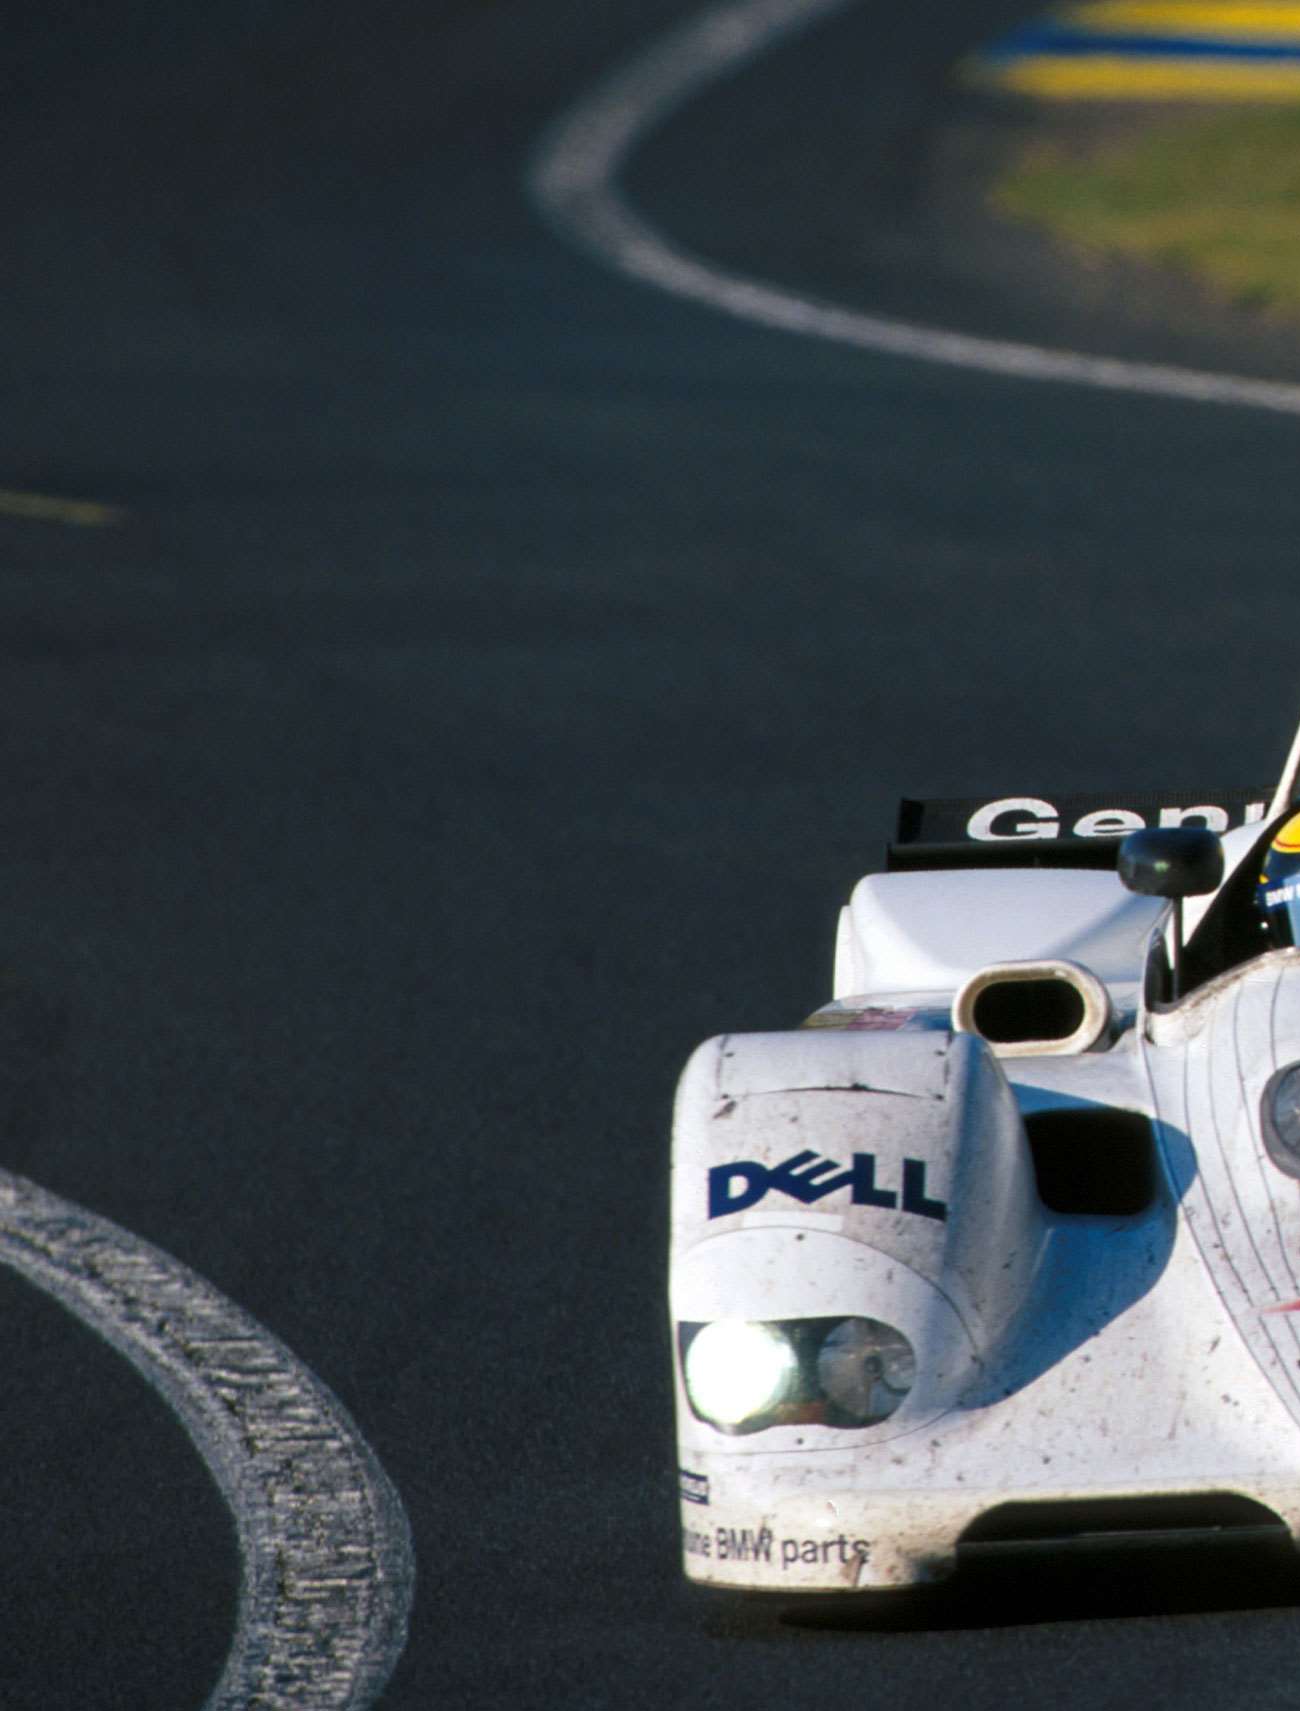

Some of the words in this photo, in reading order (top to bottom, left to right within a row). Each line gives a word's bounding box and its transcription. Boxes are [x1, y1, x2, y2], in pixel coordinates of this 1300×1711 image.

[966, 797, 1266, 842] Gen
[708, 1149, 947, 1221] DELL
[716, 1526, 774, 1563] BMW
[781, 1533, 871, 1570] parts
